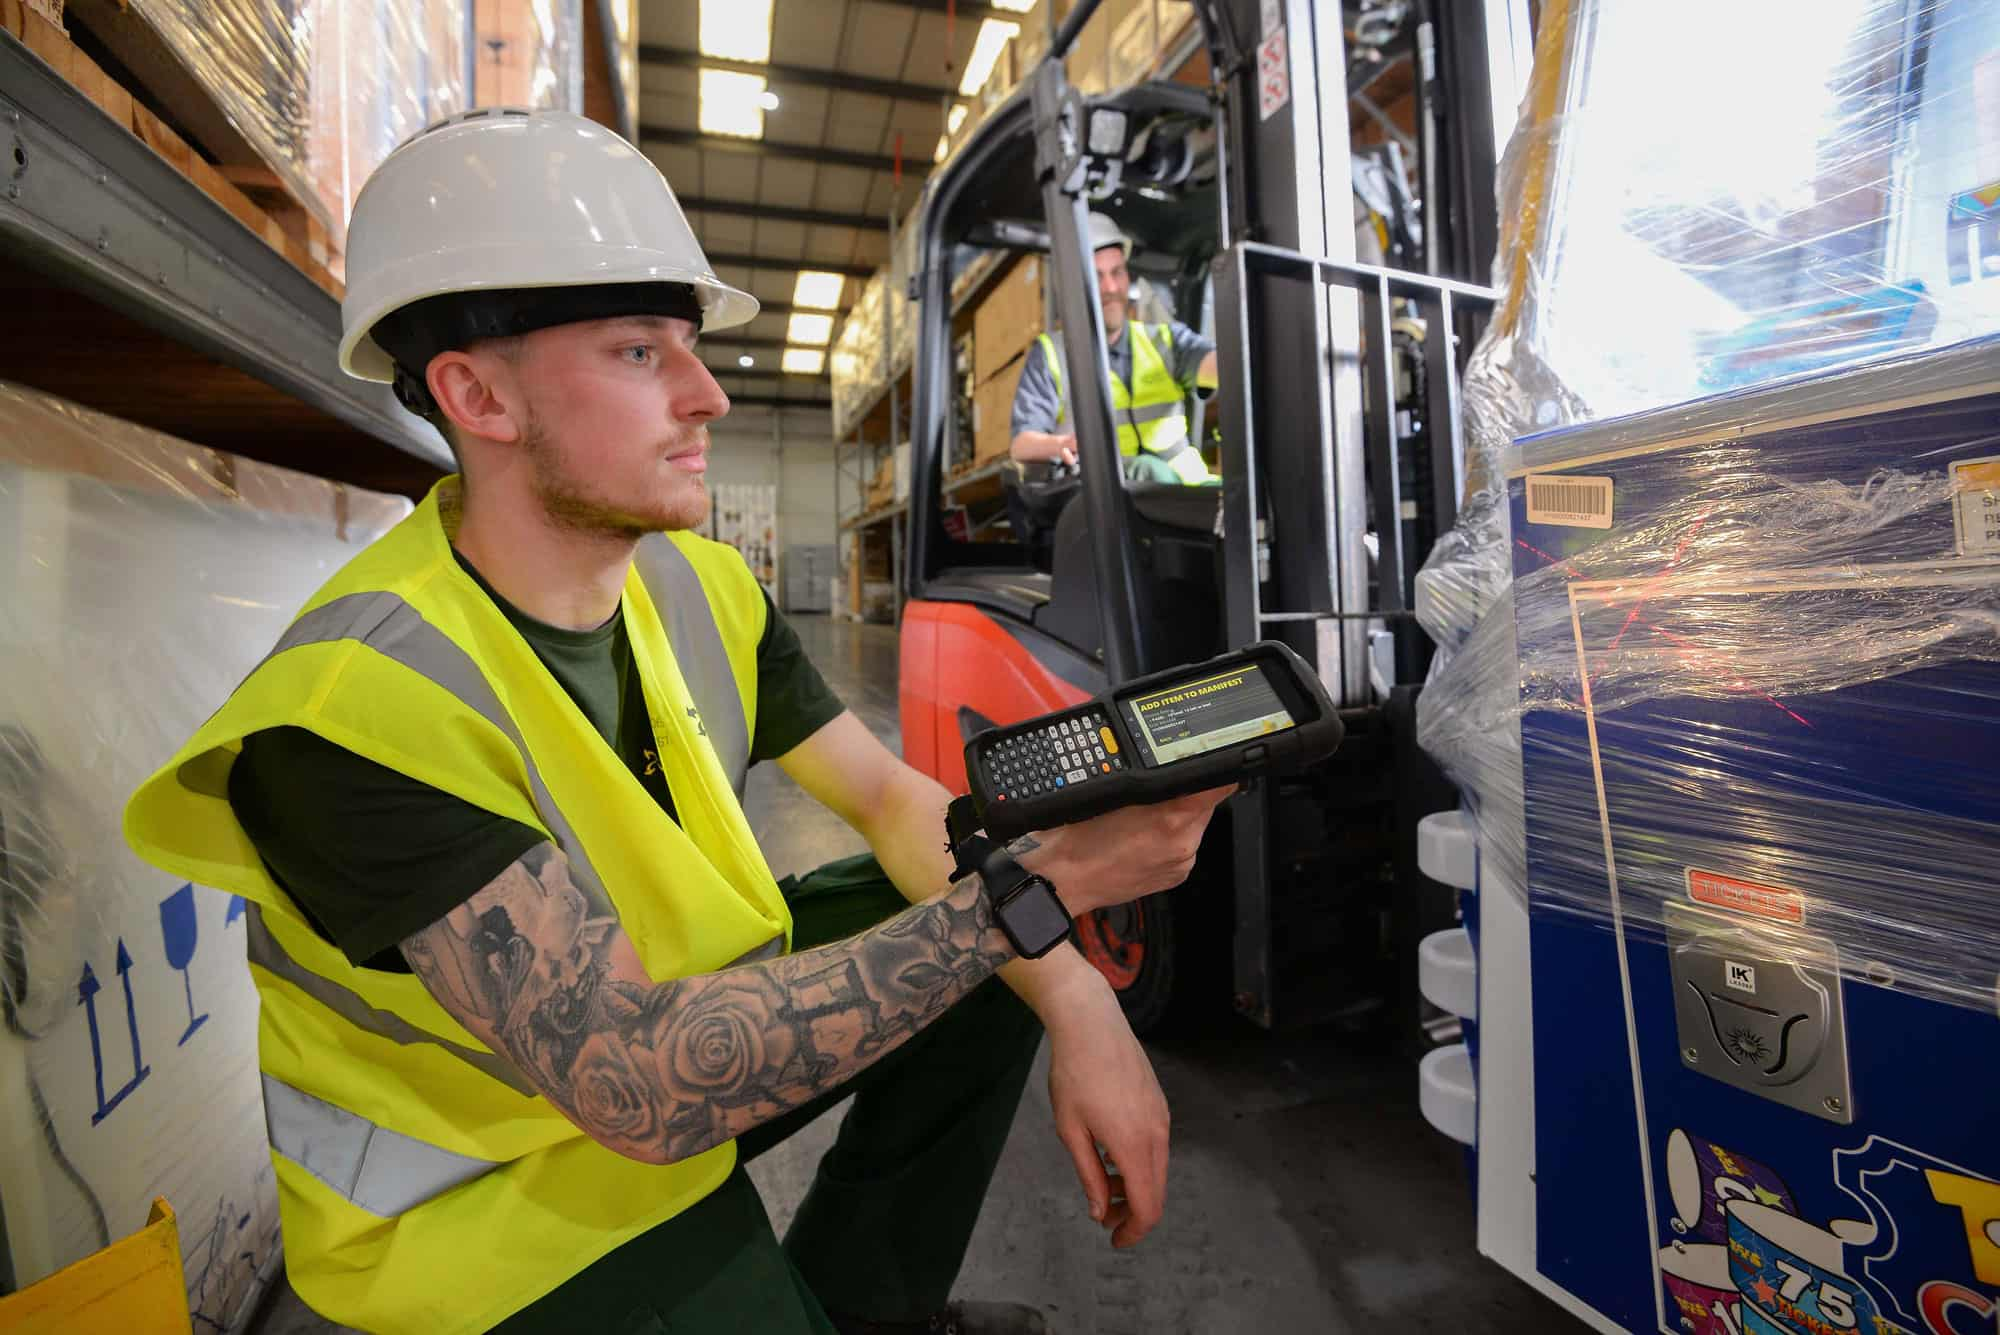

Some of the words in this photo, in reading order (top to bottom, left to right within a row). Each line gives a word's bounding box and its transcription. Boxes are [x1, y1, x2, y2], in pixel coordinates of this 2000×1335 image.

[1140, 701, 1160, 713] ADD
[1161, 693, 1184, 707] ITEM
[1185, 690, 1197, 700] TO
[1198, 677, 1243, 694] MANIFEST
[1775, 1260, 1857, 1328] 75
